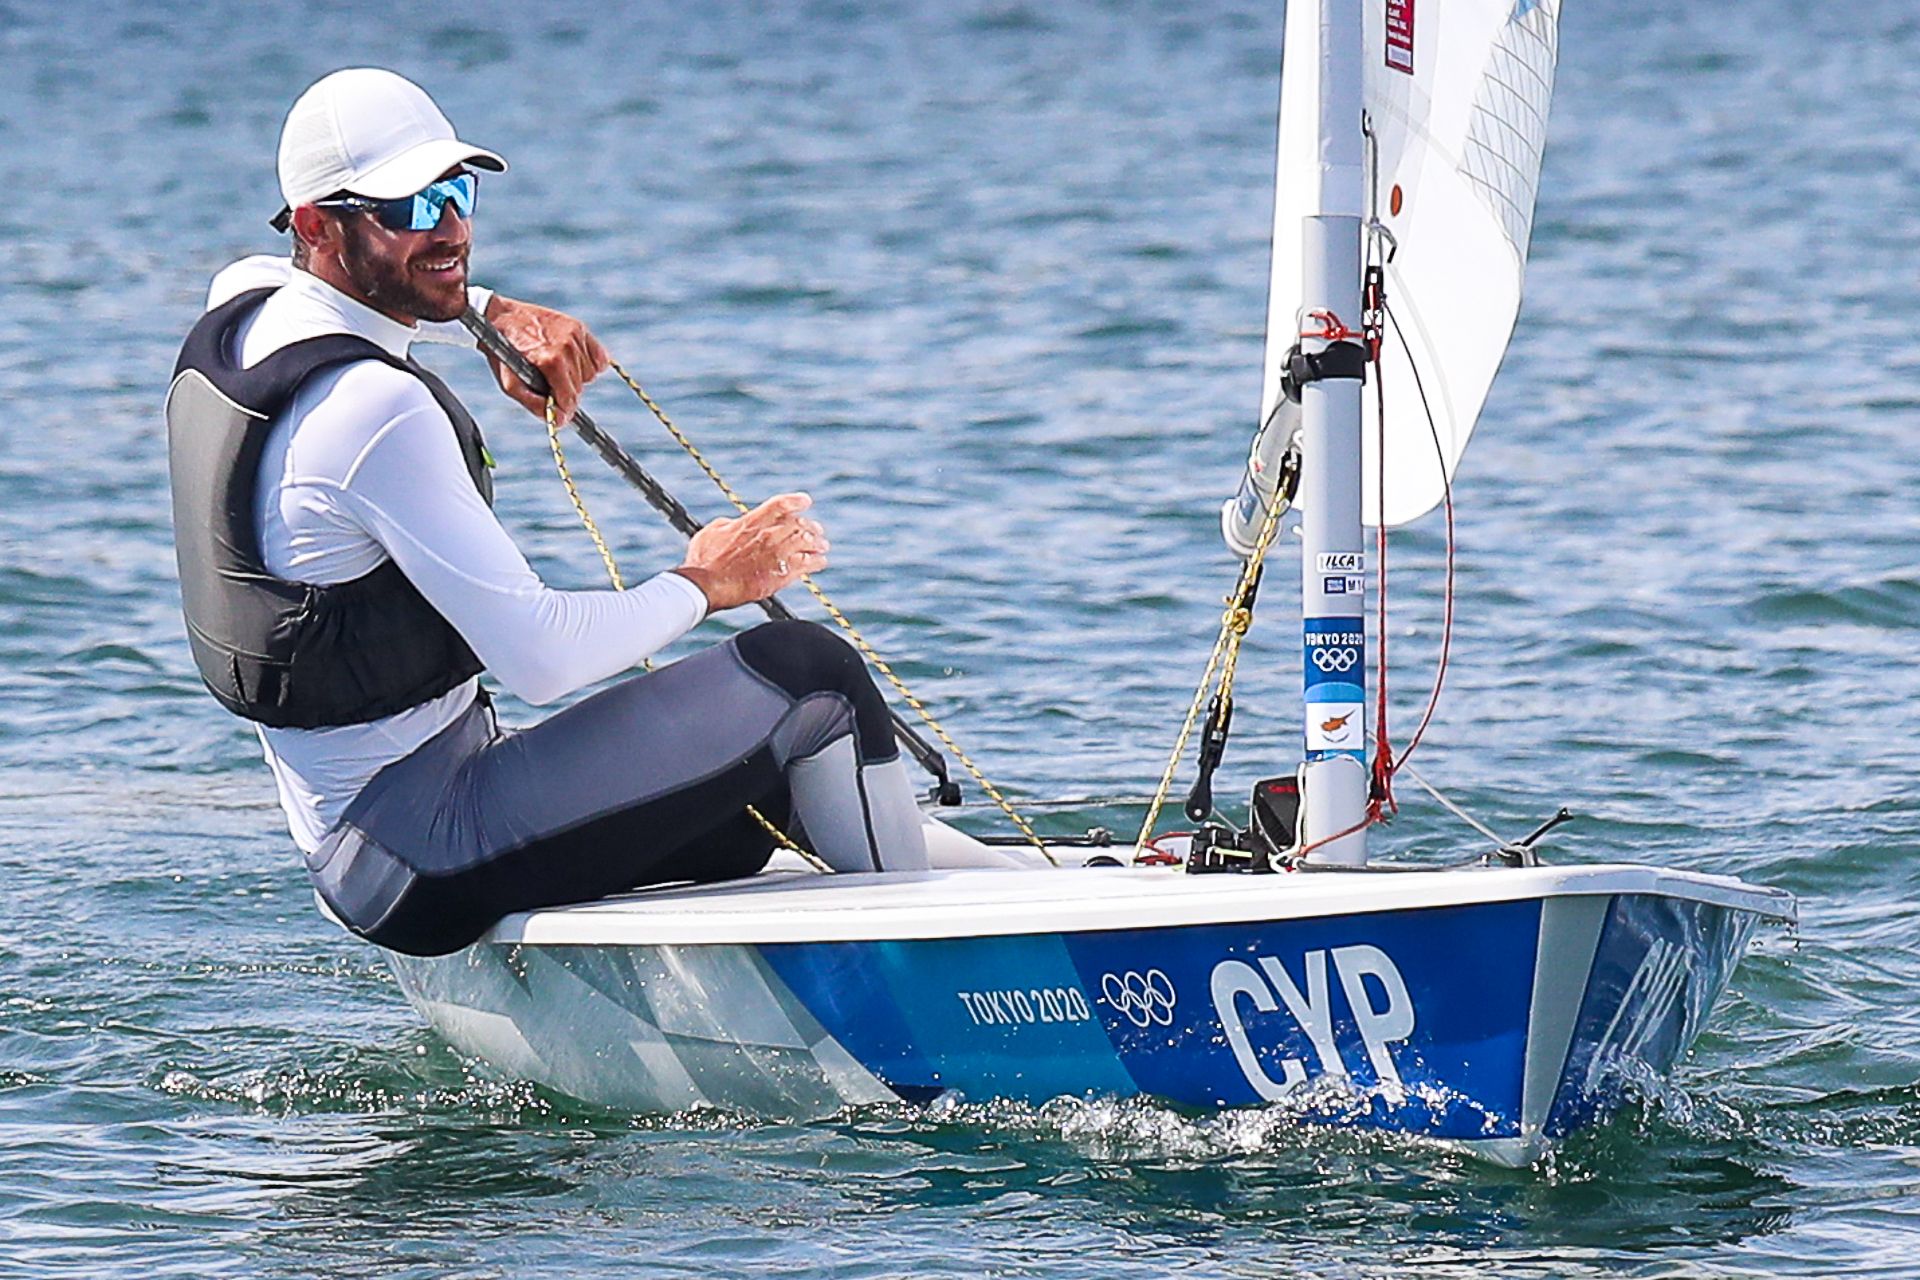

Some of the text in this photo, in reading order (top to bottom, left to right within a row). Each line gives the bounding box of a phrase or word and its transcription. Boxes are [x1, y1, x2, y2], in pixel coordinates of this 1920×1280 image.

[1326, 555, 1355, 567] ILCA
[1305, 632, 1340, 646] TOKYO
[958, 986, 1091, 1026] TOKYO 2020
[1210, 944, 1415, 1104] CYP
